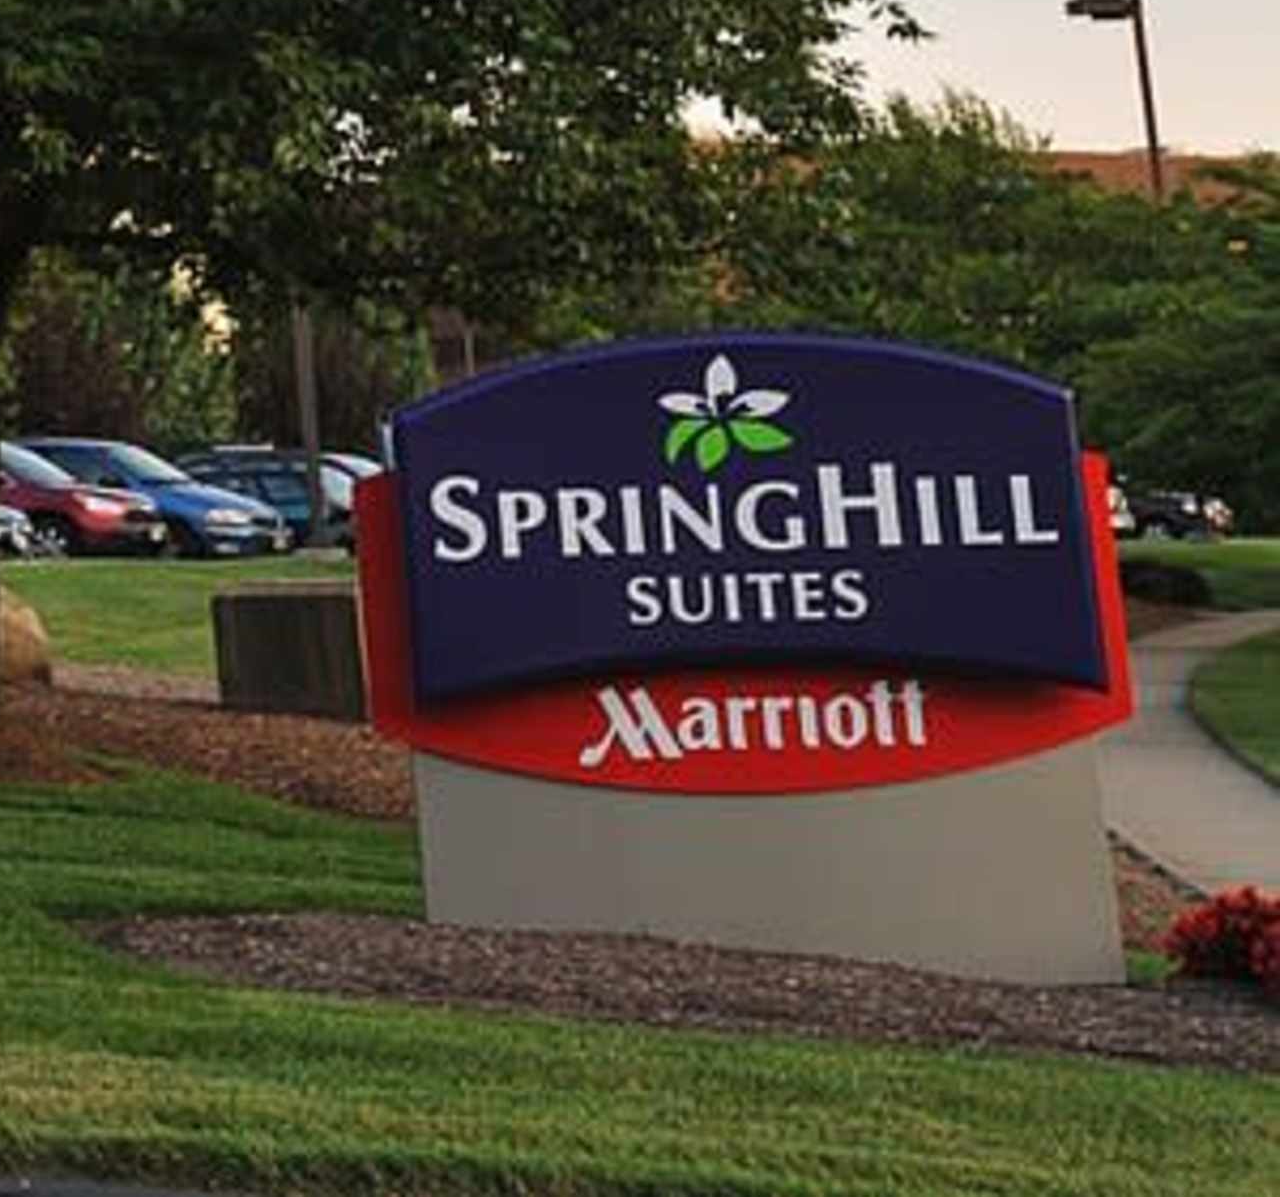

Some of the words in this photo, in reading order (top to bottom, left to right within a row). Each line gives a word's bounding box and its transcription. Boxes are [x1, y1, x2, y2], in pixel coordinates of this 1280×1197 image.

[429, 462, 1060, 562] SPRINGHILL
[626, 569, 869, 625] SUITES
[578, 680, 927, 767] Marriott
